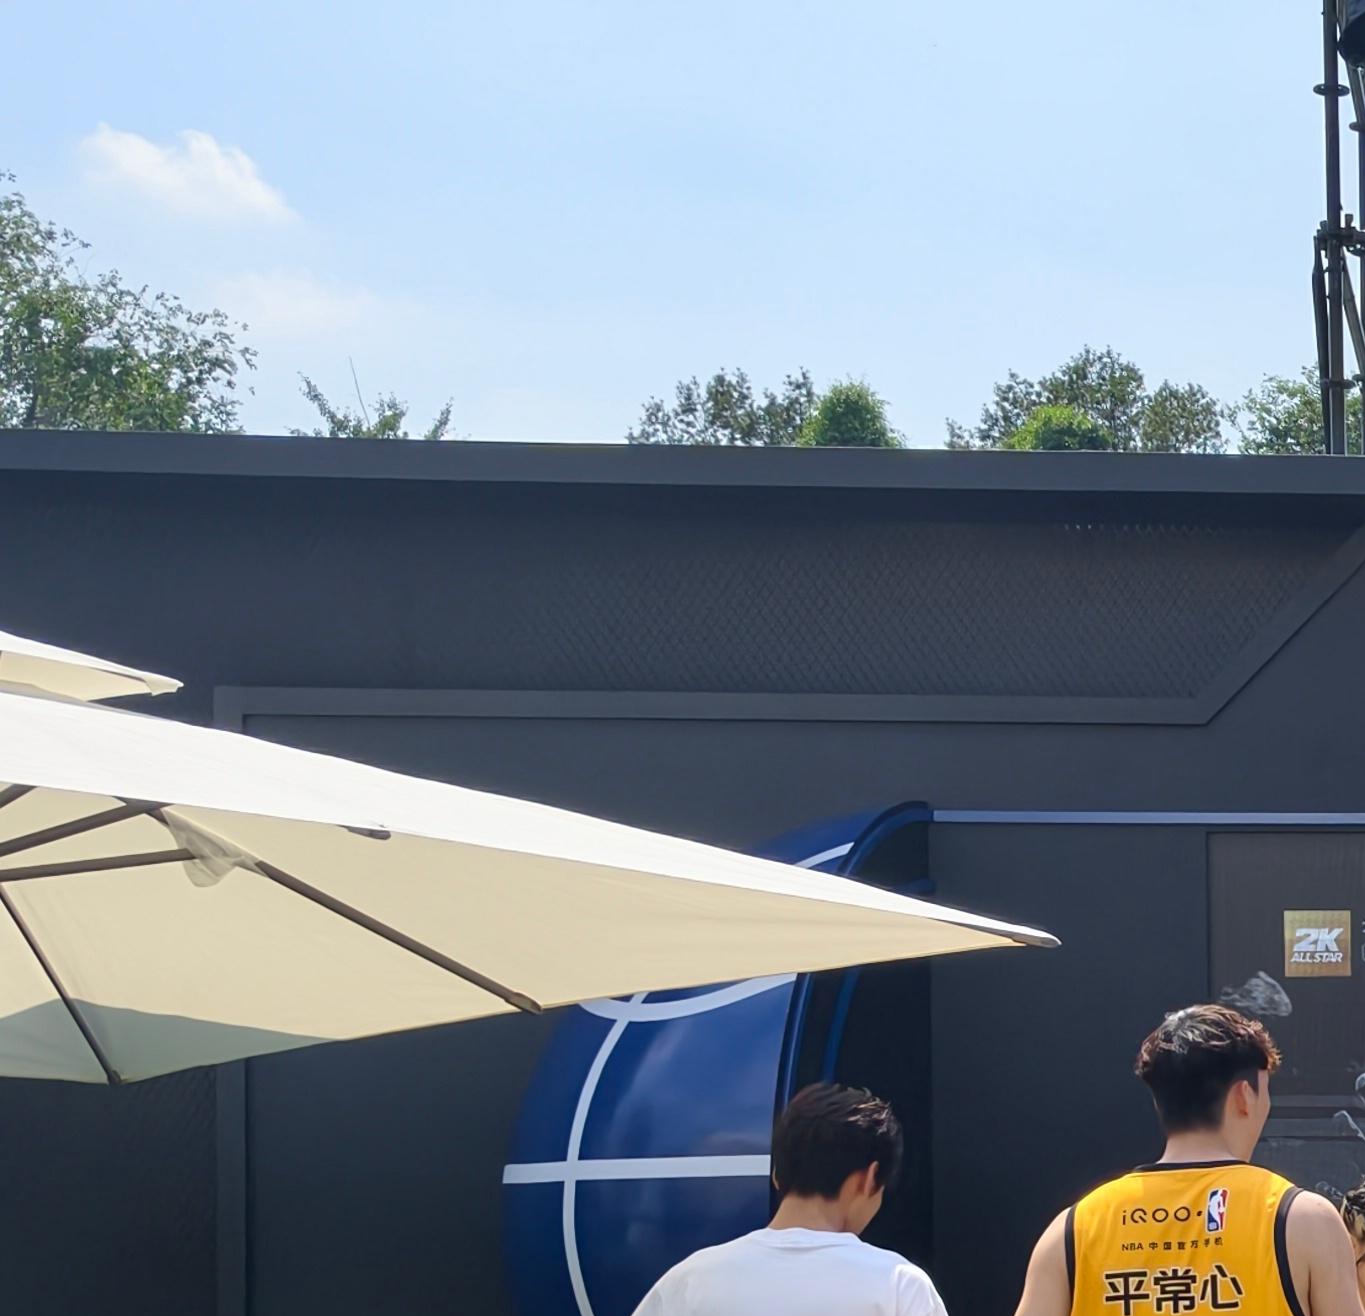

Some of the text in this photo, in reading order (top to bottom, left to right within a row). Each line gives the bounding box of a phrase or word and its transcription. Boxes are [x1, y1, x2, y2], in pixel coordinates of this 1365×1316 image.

[1293, 927, 1344, 951] 2K
[1122, 1206, 1191, 1226] iQOO
[1121, 1242, 1144, 1252] NBA
